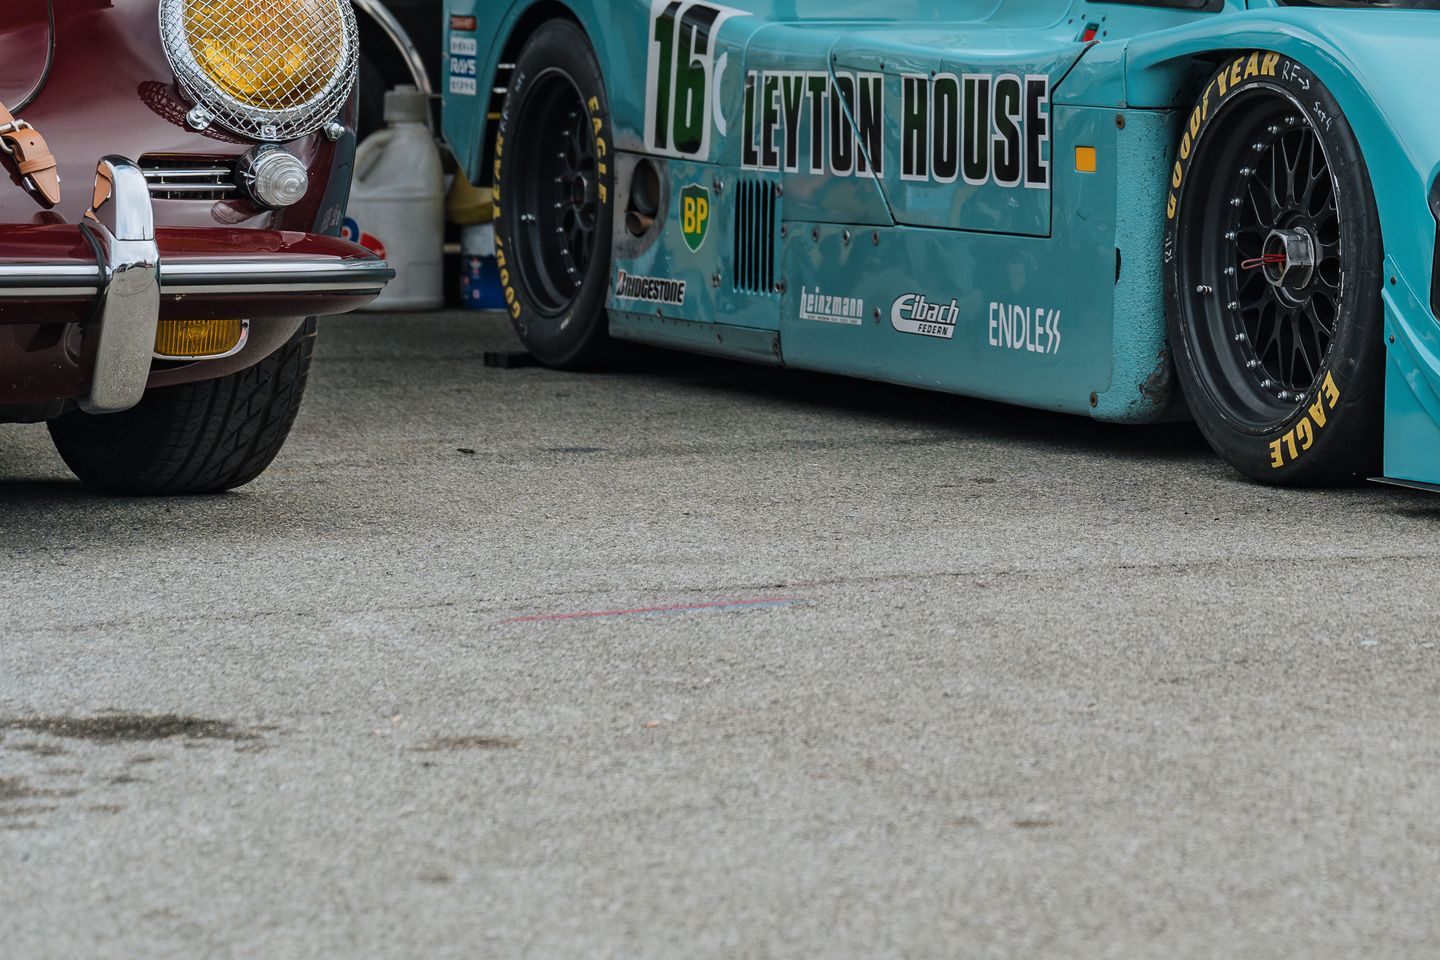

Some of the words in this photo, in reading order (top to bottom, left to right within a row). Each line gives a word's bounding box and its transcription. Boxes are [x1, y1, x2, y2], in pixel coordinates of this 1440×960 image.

[450, 57, 476, 74] RAYS
[652, 0, 722, 156] 16
[741, 71, 885, 178] LEYTON
[900, 72, 1050, 189] HOUSE
[587, 95, 607, 204] EAGLE
[683, 196, 708, 235] BP
[616, 271, 686, 304] BRIDGESTONE
[799, 285, 864, 319] heinzmann
[891, 293, 960, 327] Eibach
[988, 301, 1061, 355] ENDLESS
[917, 323, 949, 336] FEDERN
